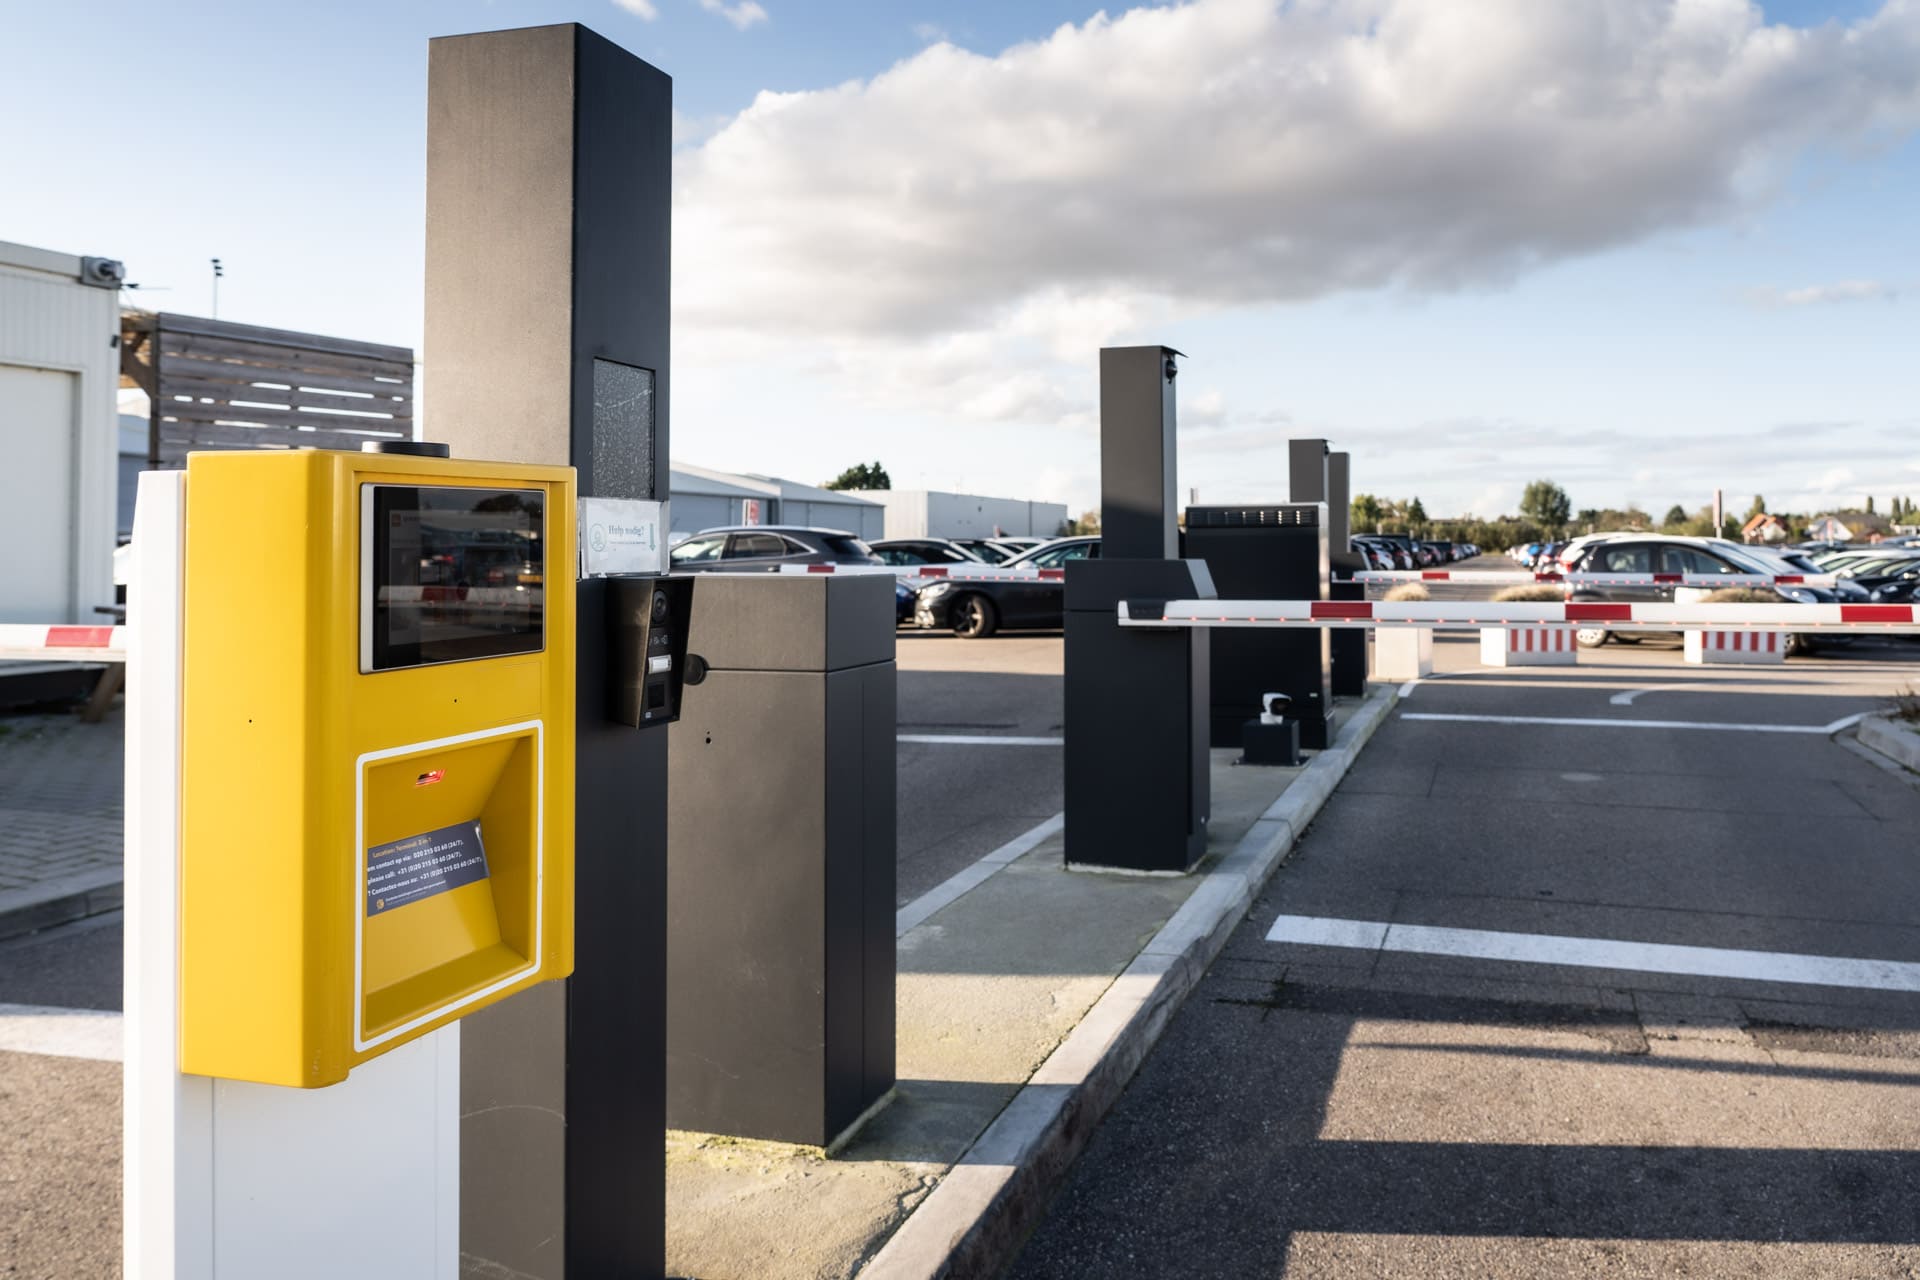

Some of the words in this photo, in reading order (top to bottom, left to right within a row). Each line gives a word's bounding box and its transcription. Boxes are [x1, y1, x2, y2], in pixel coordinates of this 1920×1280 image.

[608, 524, 624, 536] Help
[376, 860, 395, 869] contact
[367, 876, 384, 886] please
[408, 863, 422, 872] (0)20
[371, 880, 410, 895] Contactez-nous
[430, 869, 443, 878] (0)20
